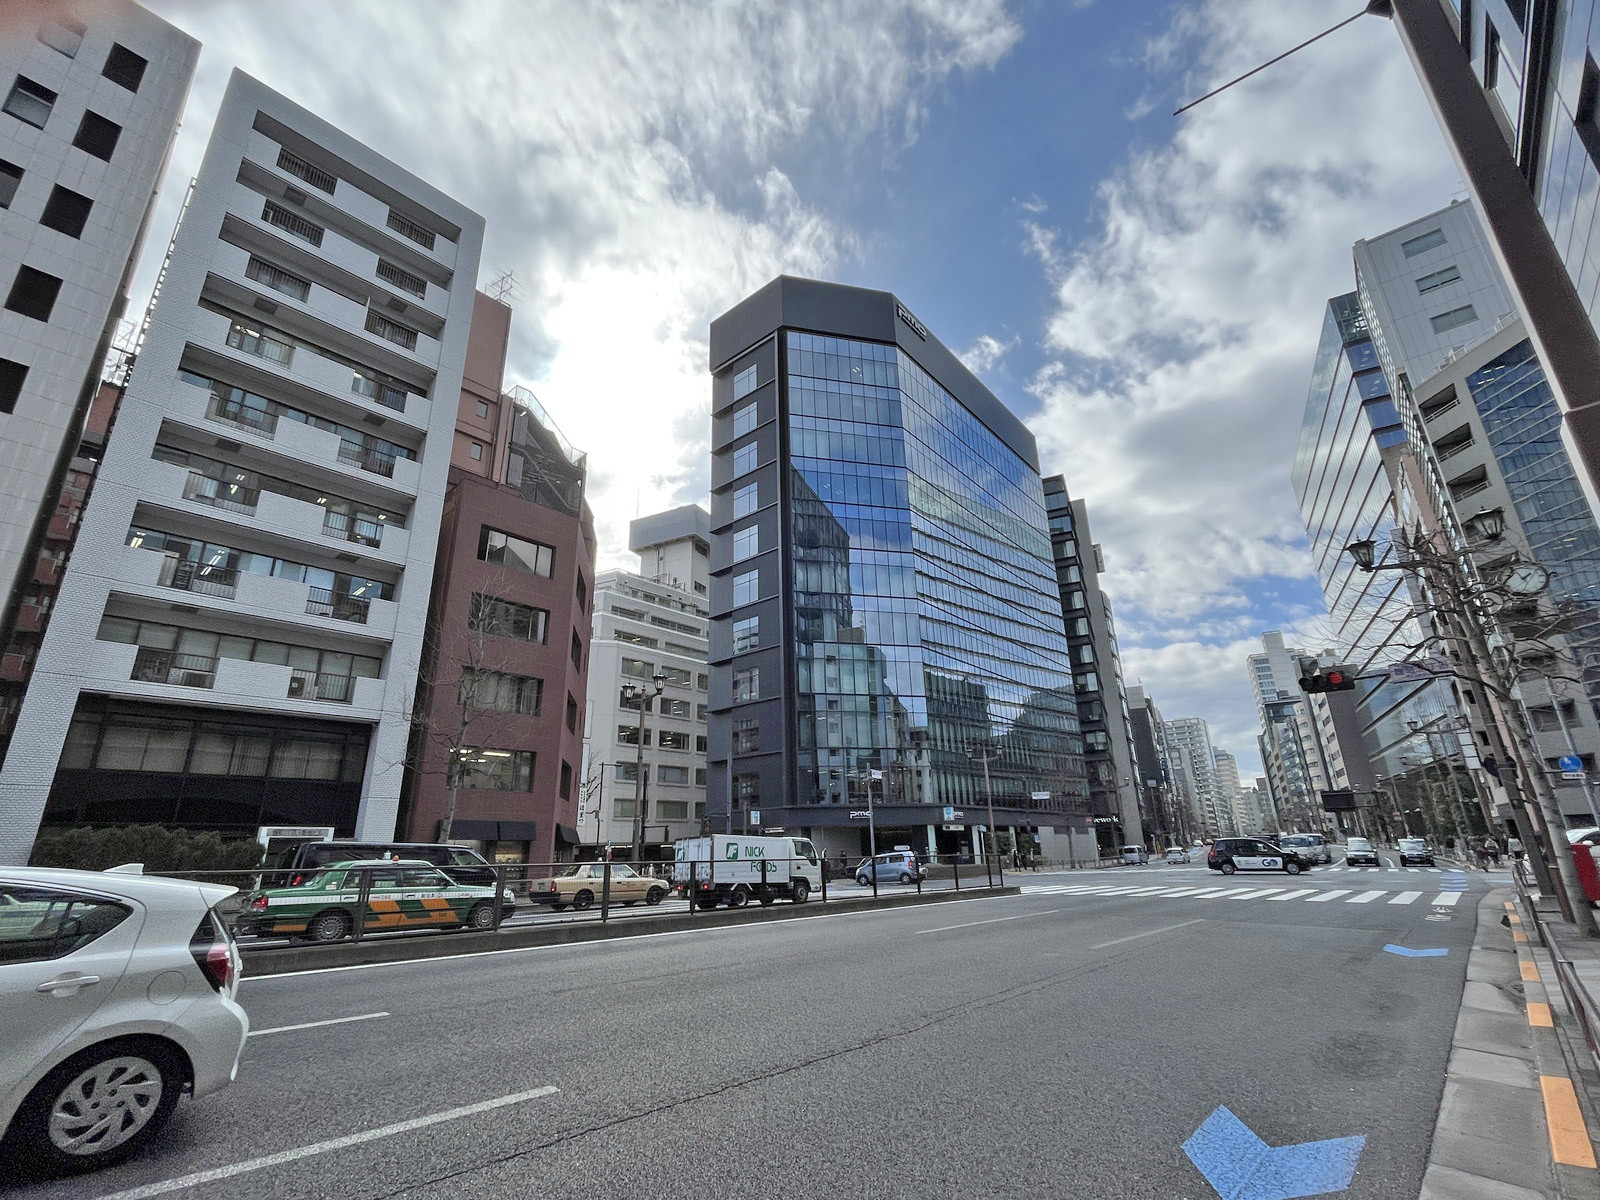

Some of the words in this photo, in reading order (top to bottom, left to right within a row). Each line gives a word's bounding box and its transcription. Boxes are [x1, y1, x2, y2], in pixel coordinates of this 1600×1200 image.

[744, 846, 765, 858] NICK
[750, 861, 778, 873] FODS
[1261, 858, 1279, 867] GO
